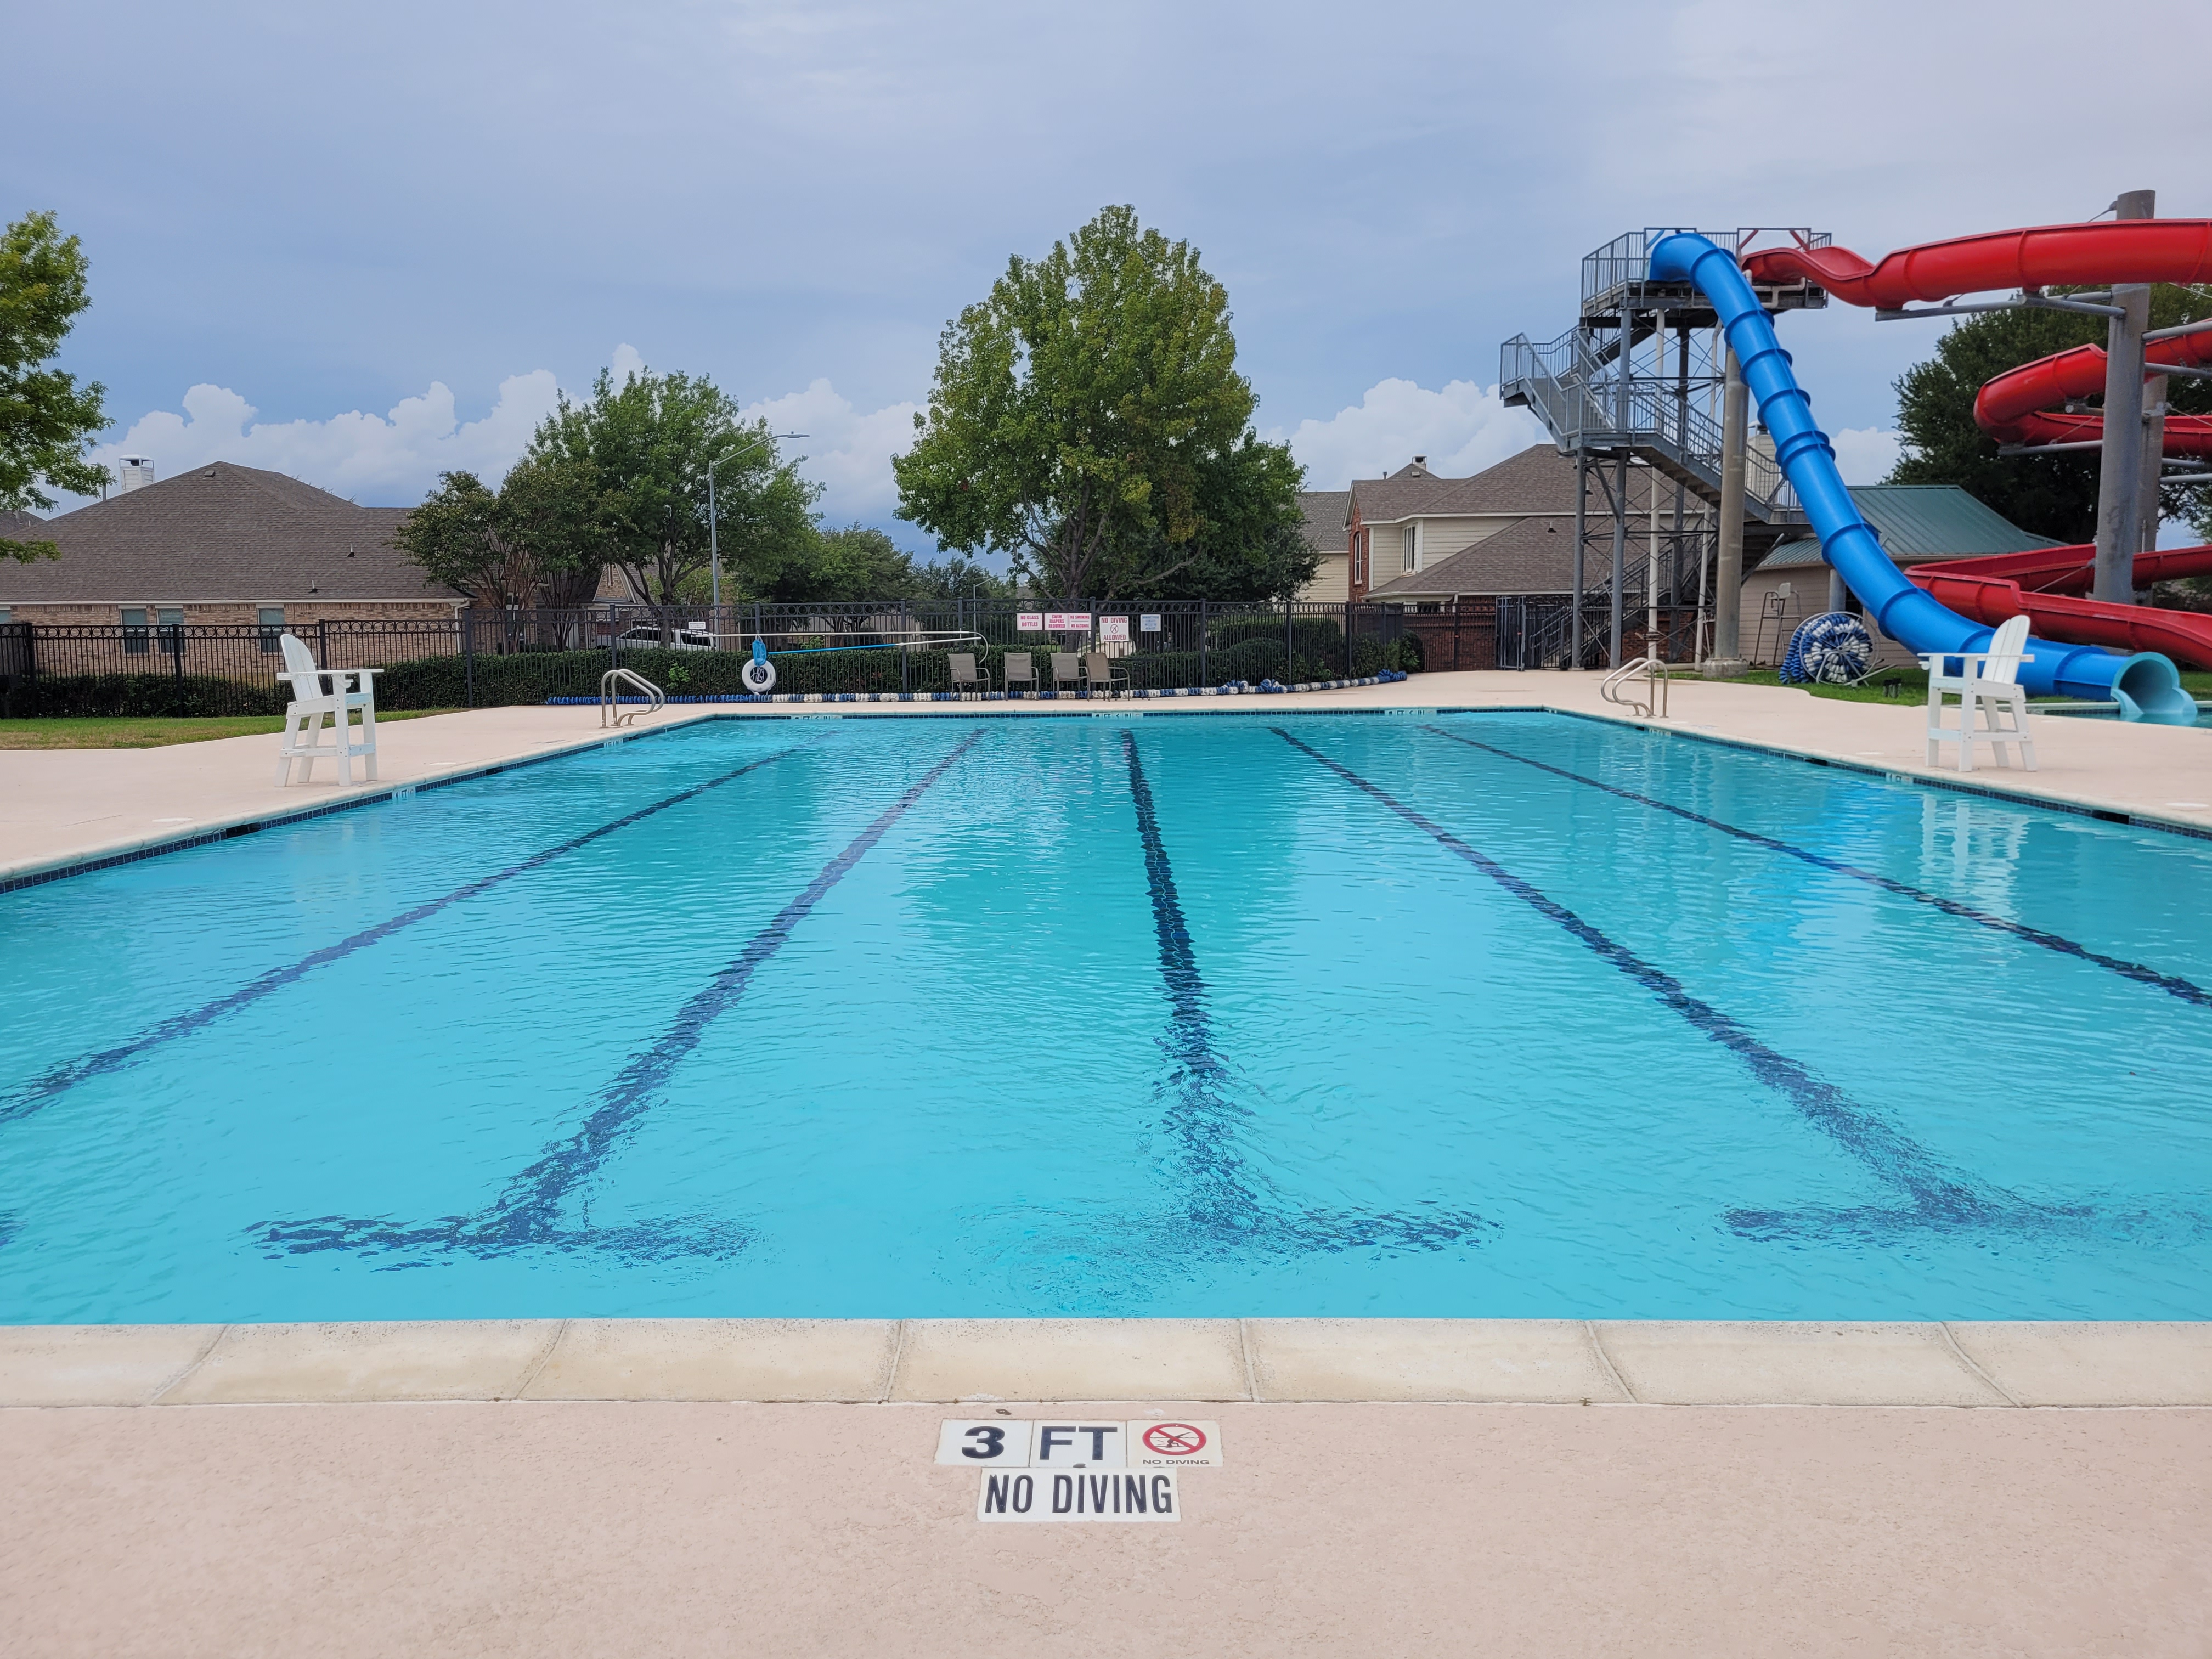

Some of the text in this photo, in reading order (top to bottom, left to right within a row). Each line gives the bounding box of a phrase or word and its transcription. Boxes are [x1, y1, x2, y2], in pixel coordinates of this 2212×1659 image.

[961, 1425, 1118, 1461] 3 FT
[984, 1474, 1172, 1514] NO DIVING
